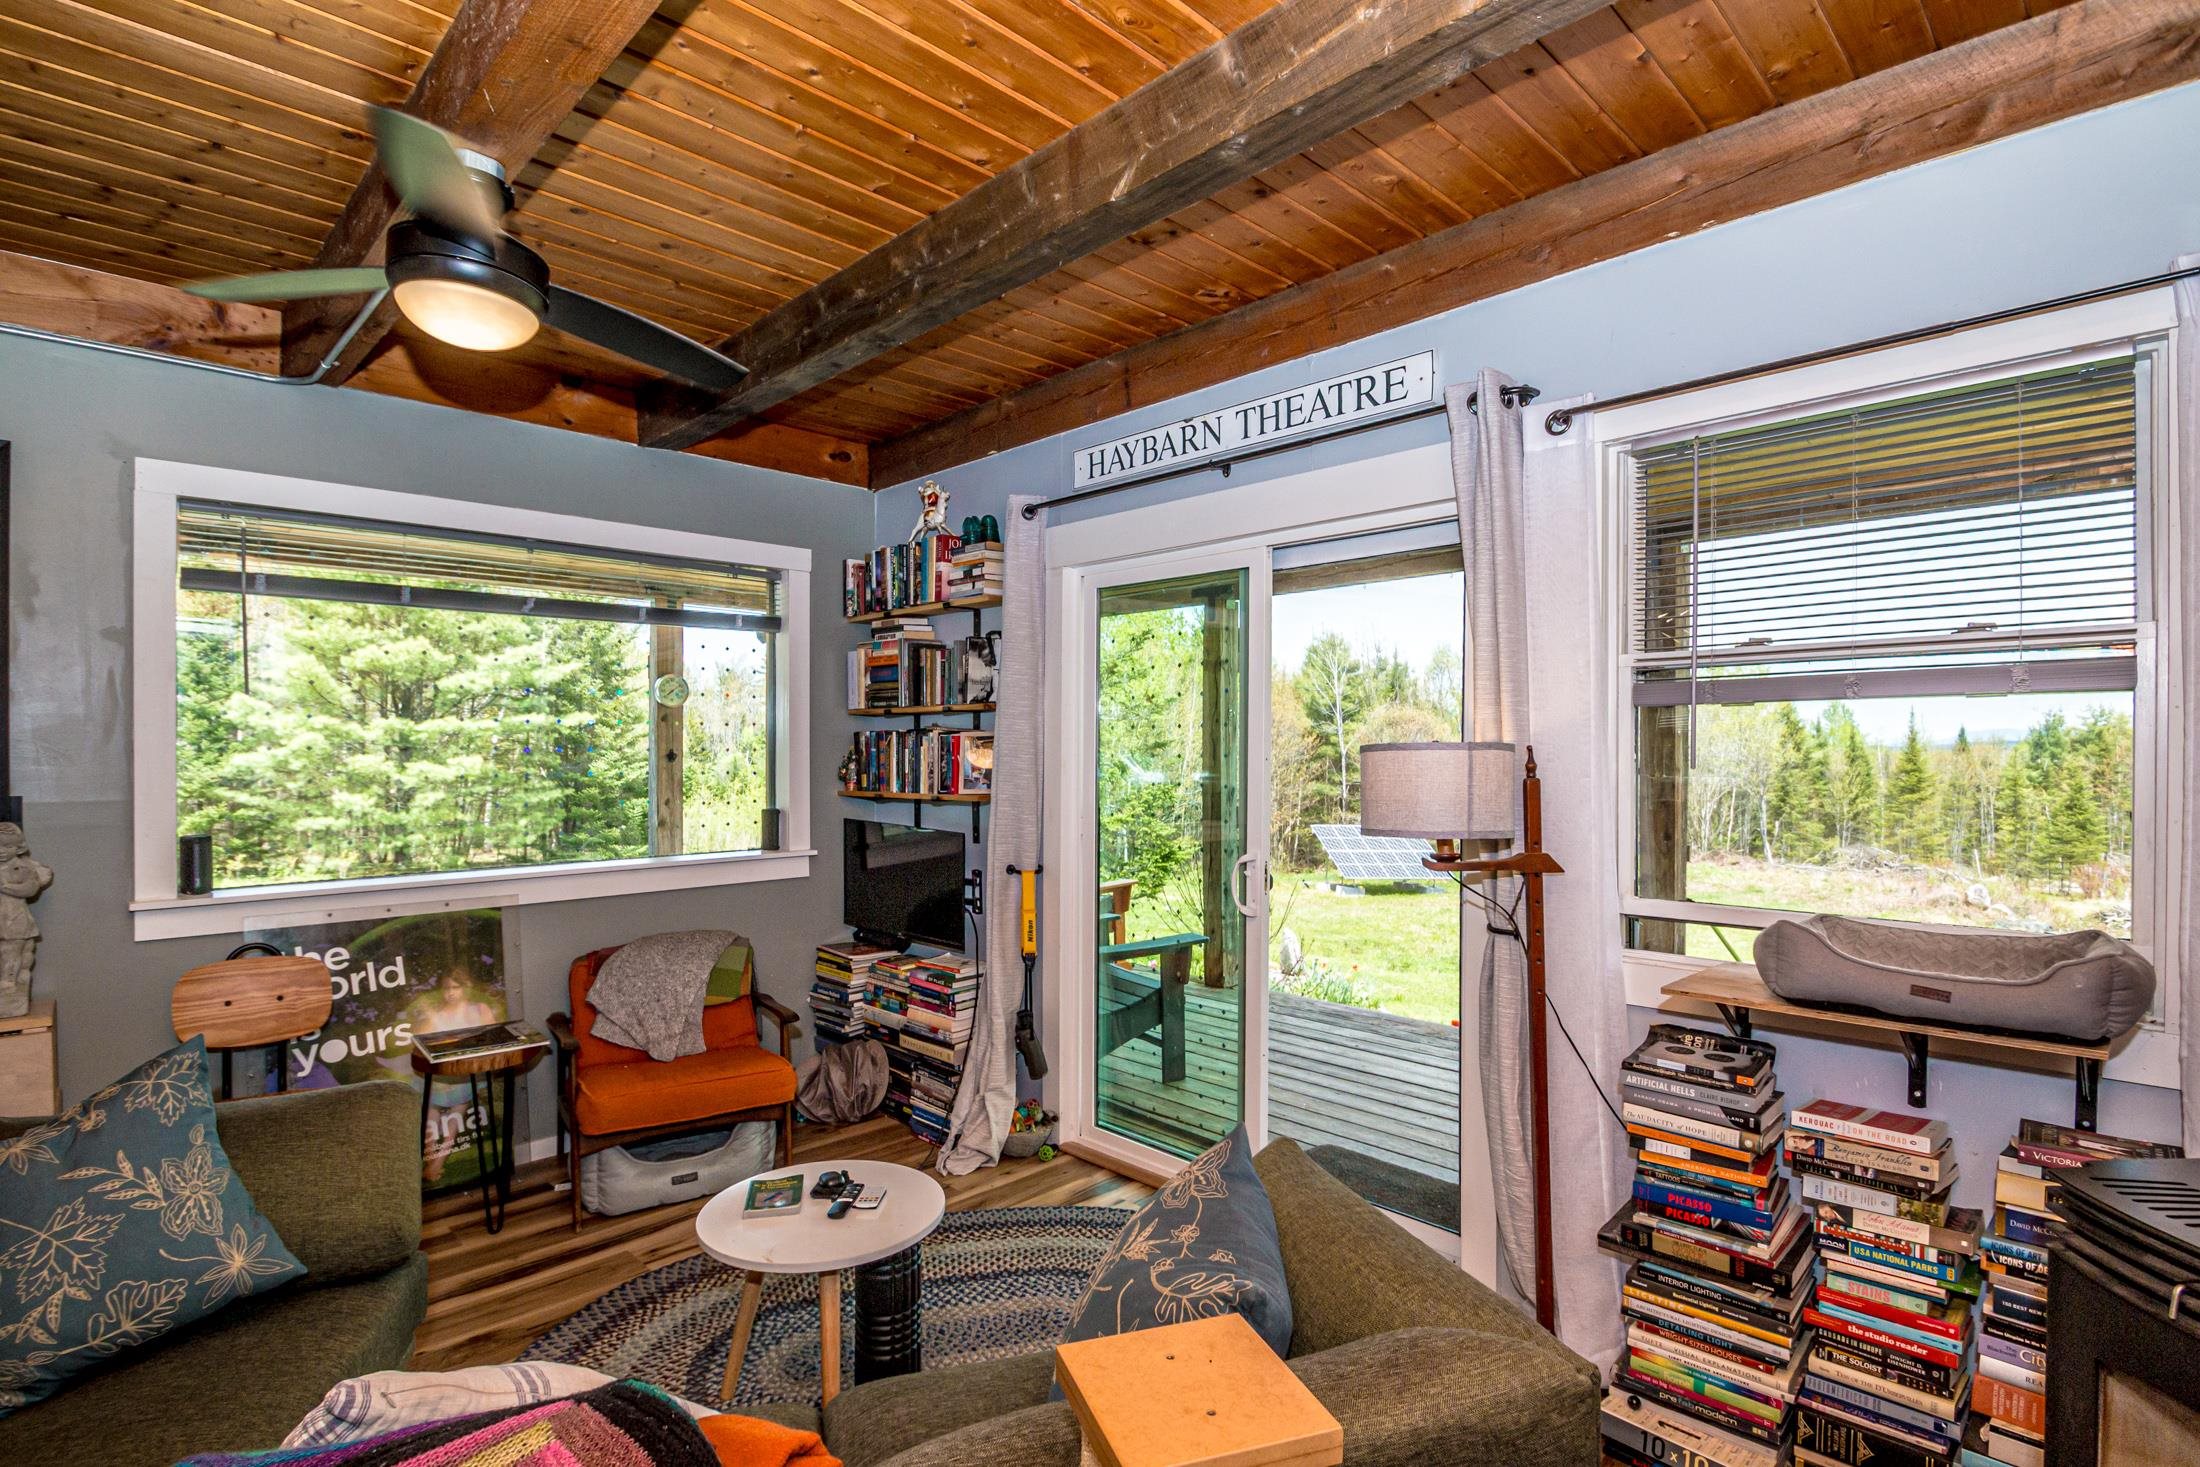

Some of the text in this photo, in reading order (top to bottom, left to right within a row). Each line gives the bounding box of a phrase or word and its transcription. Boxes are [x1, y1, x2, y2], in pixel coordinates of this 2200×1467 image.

[1088, 365, 1409, 480] HAYBARN THEATRE
[331, 956, 407, 1000] orld
[291, 1023, 414, 1078] yours
[1626, 1074, 1669, 1092] ARTIFICIAL
[1670, 1083, 1696, 1097] HELLS
[1636, 1113, 1674, 1128] AUDACITY
[1685, 1125, 1707, 1136] HOPE
[1798, 1115, 1908, 1145] KEROUAC ON THE ROAD
[1826, 1142, 1913, 1168] Benjamin Franklin
[2032, 1151, 2083, 1168] VICTORIA
[1655, 1171, 1681, 1184] TATTOOS
[1681, 1162, 1717, 1174] AMERICAN
[1719, 1170, 1751, 1182] NATIONS
[1667, 1193, 1712, 1212] PICASSO
[1665, 1207, 1710, 1226] PICASSO
[1819, 1237, 1845, 1250] MOON
[1991, 1241, 2043, 1261] ICONS OF ART
[1854, 1246, 1871, 1258] USA
[1872, 1251, 1909, 1267] NATIONAL
[1910, 1260, 1939, 1275] PARKS
[1999, 1255, 2024, 1269] ICONS
[2025, 1262, 2036, 1271] OF
[1658, 1274, 1689, 1290] INTERIOR
[1689, 1284, 1722, 1301] LIGHTING
[1629, 1287, 1686, 1312] LIGHTING
[1699, 1299, 1719, 1312] Lighting
[2012, 1304, 2028, 1312] BEST
[2028, 1308, 2043, 1316] NEW
[1658, 1319, 1735, 1350] DETAILING LIGHT
[1818, 1327, 1850, 1345] CRUSADE
[1850, 1338, 1858, 1348] IN
[1858, 1341, 1883, 1356] EUROPE
[1847, 1325, 1863, 1336] the
[1863, 1331, 1895, 1346] studio
[1895, 1341, 1929, 1356] reader
[1673, 1346, 1700, 1360] VISUAL
[1702, 1356, 1763, 1384] EXPLANATIONS
[1710, 1346, 1743, 1363] HOUSES
[1832, 1351, 1883, 1374] THE SOLOIST
[1887, 1358, 1927, 1376] EISENHOWER
